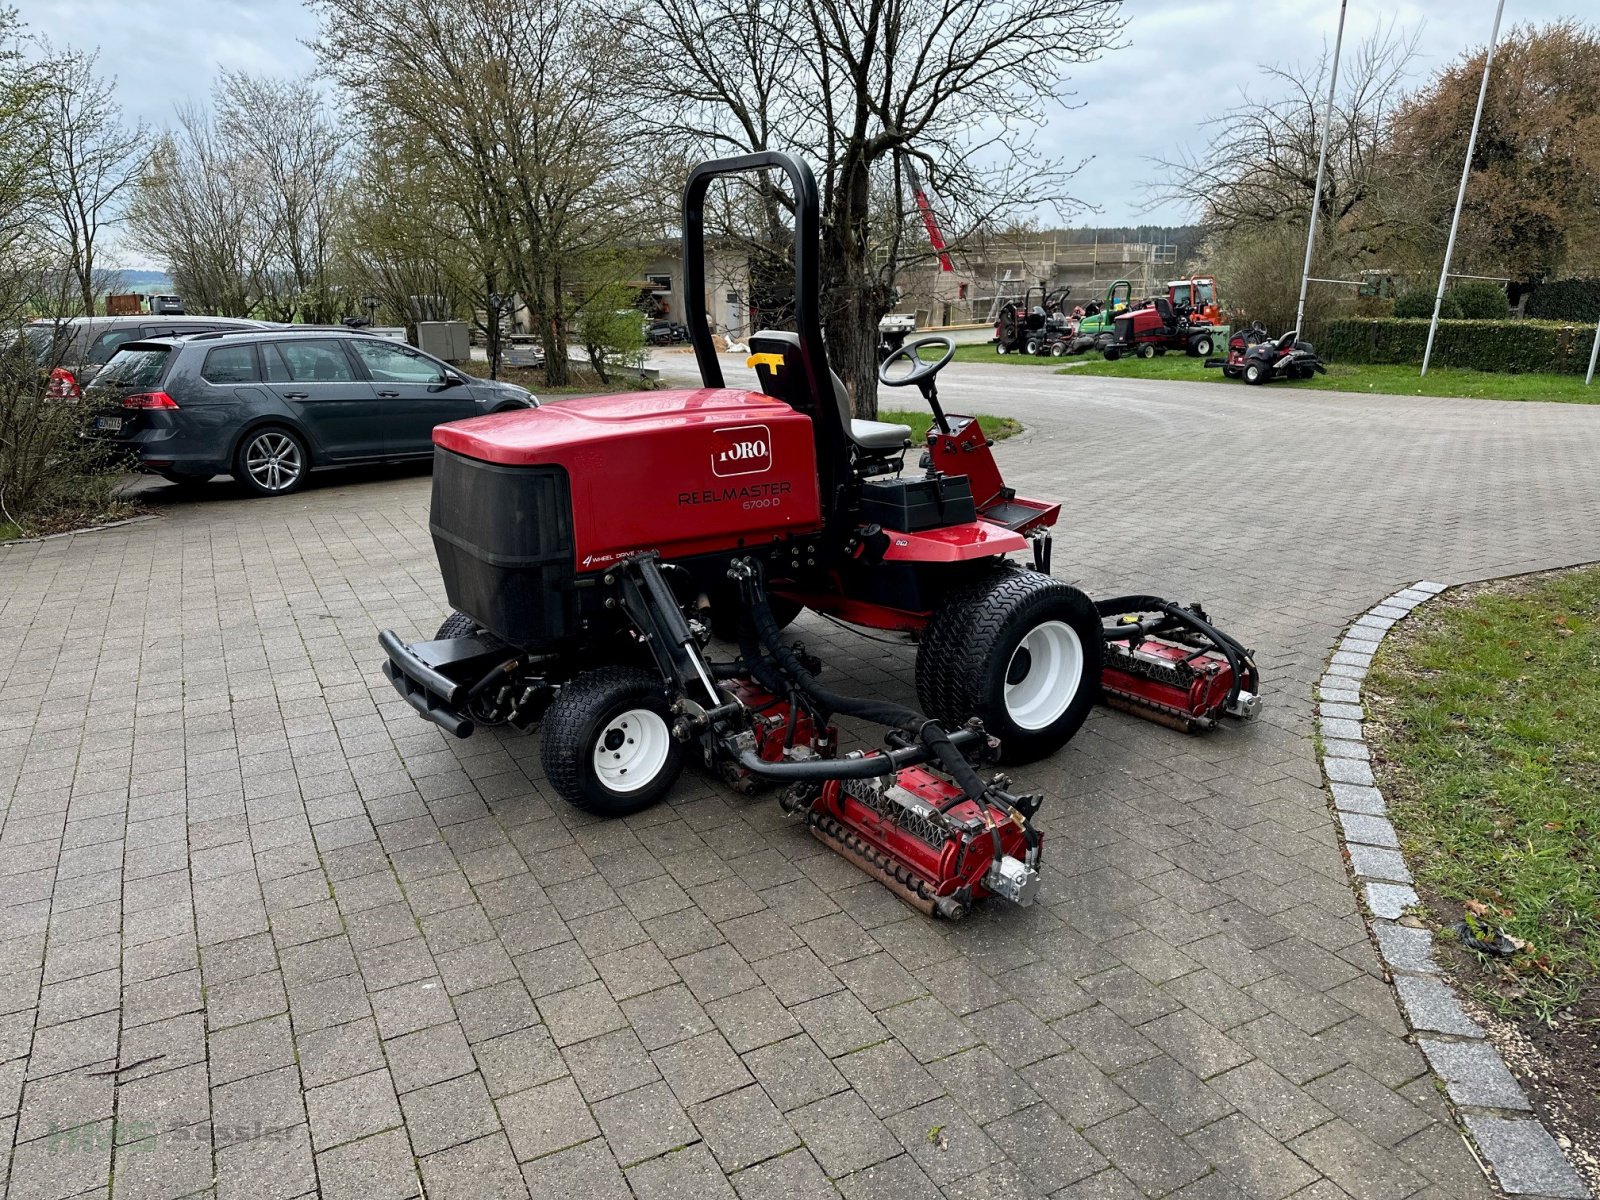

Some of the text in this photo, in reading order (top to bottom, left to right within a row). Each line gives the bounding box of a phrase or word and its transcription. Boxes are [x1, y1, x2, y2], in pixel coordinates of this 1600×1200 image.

[678, 482, 791, 505] REELMASTER
[582, 555, 593, 567] 4
[592, 555, 614, 563] WHEEL
[616, 551, 635, 559] DRIVE
